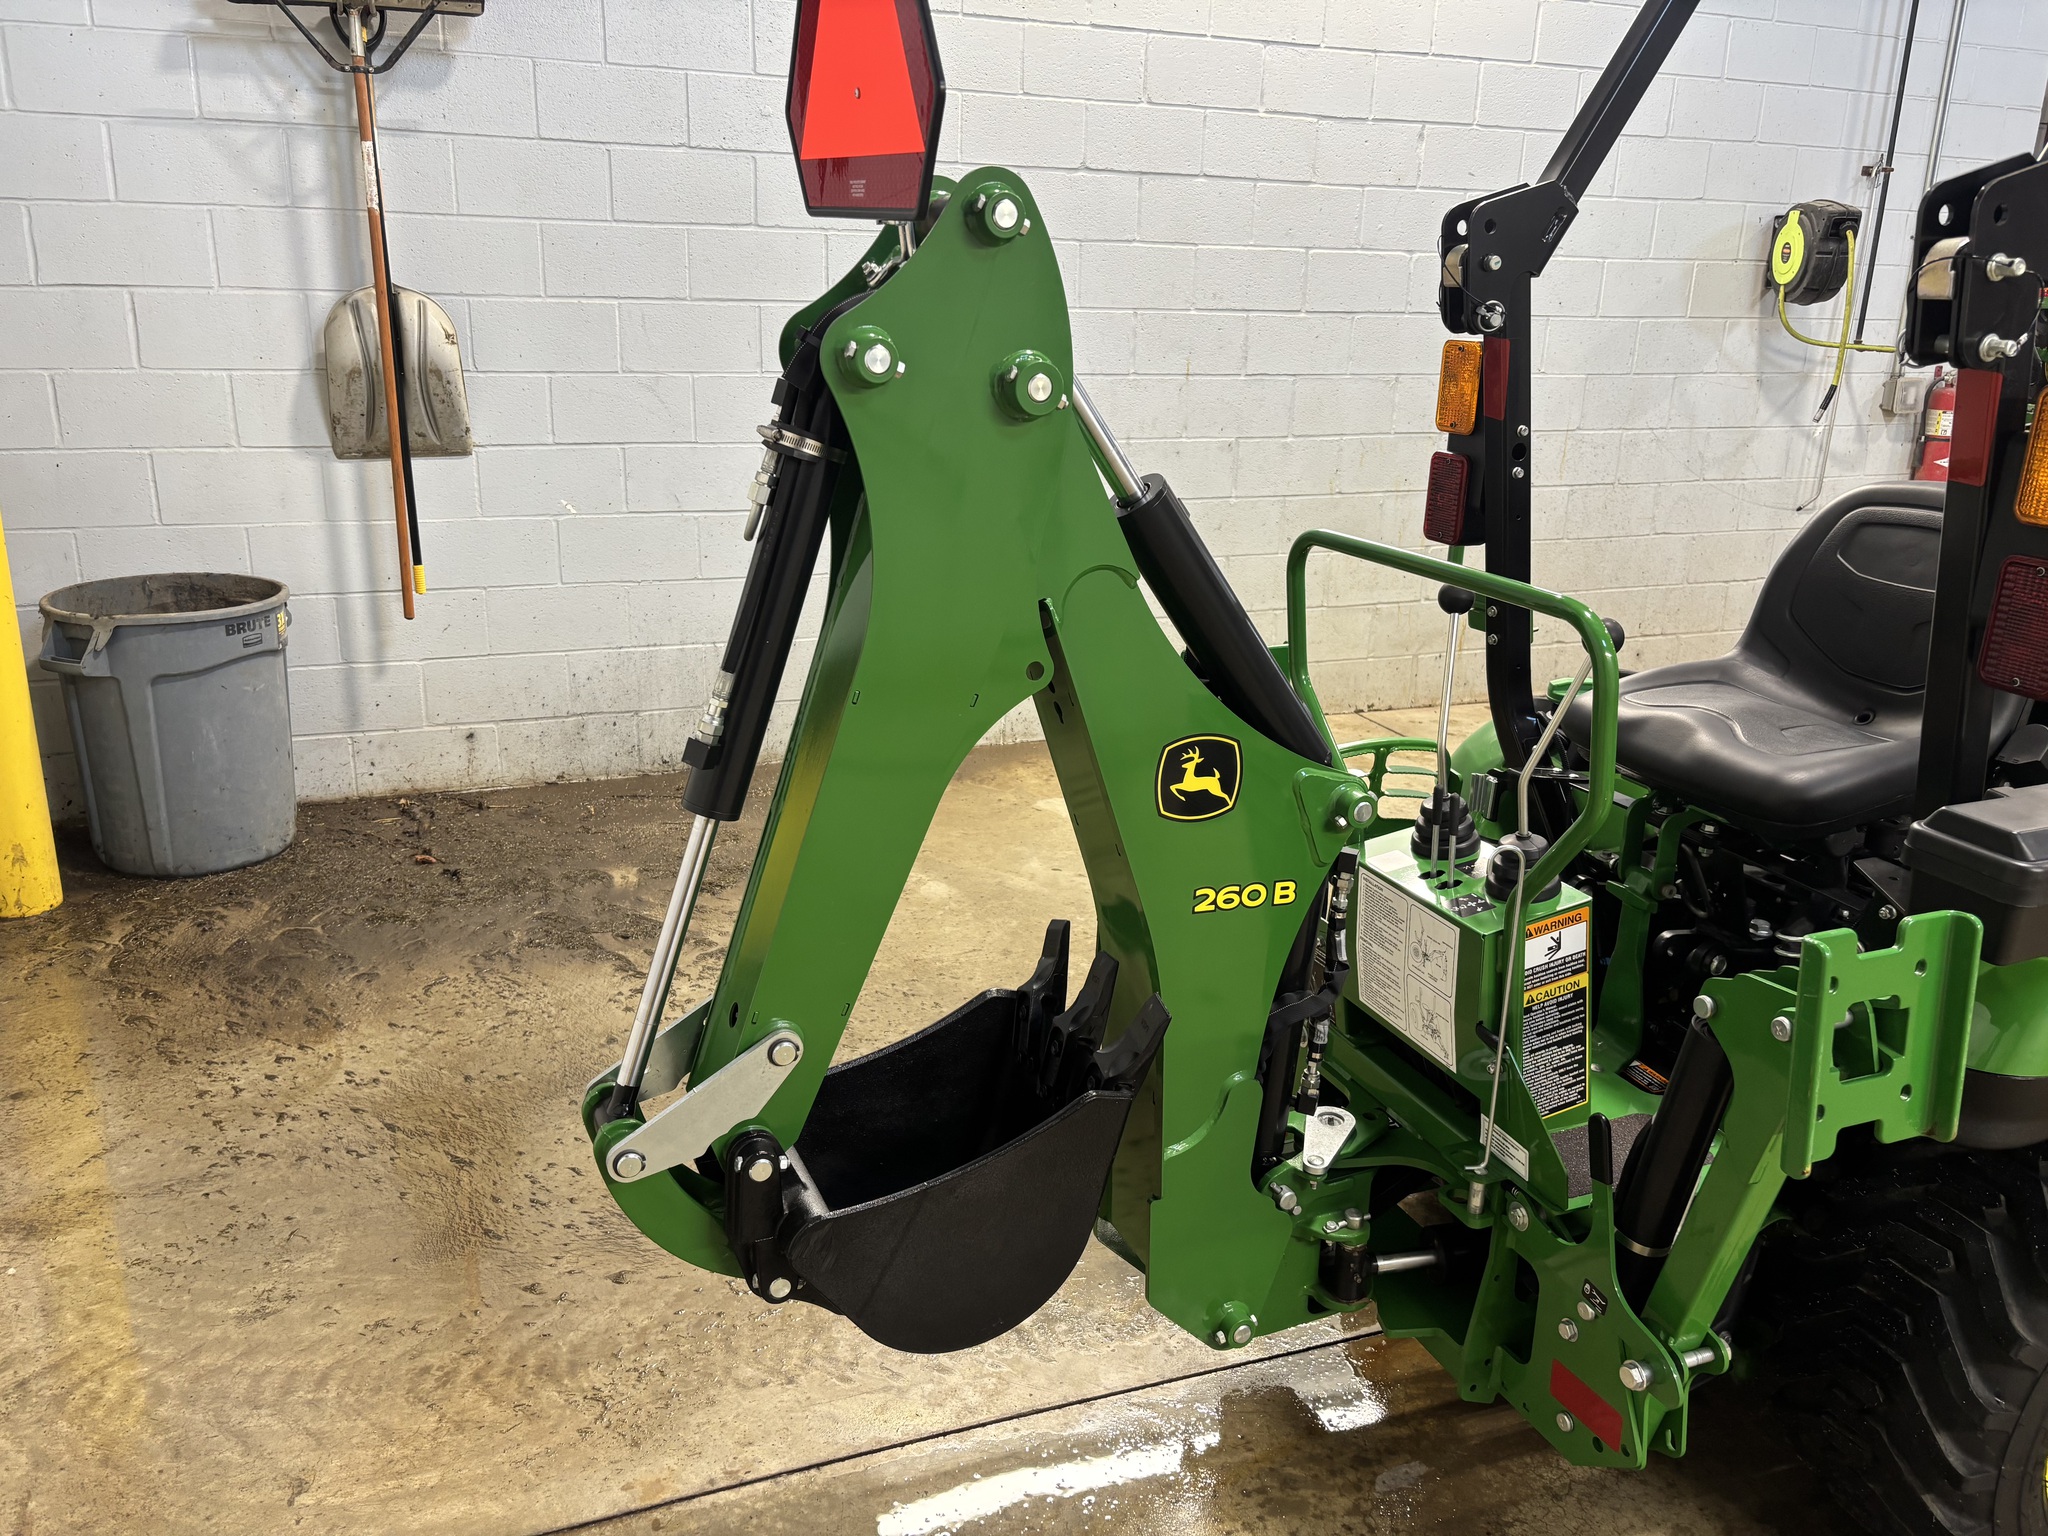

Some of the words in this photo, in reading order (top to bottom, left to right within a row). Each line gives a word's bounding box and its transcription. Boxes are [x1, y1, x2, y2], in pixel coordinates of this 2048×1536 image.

[225, 614, 271, 636] BRUTE
[1192, 882, 1268, 914] 260
[1271, 879, 1298, 906] B
[1534, 913, 1582, 936] WARNING
[1533, 963, 1549, 974] CRUSH
[1549, 958, 1565, 969] INJURY
[1536, 979, 1580, 1002] CAUTION
[1543, 998, 1557, 1008] AVOID
[1557, 992, 1574, 1002] INJURY
